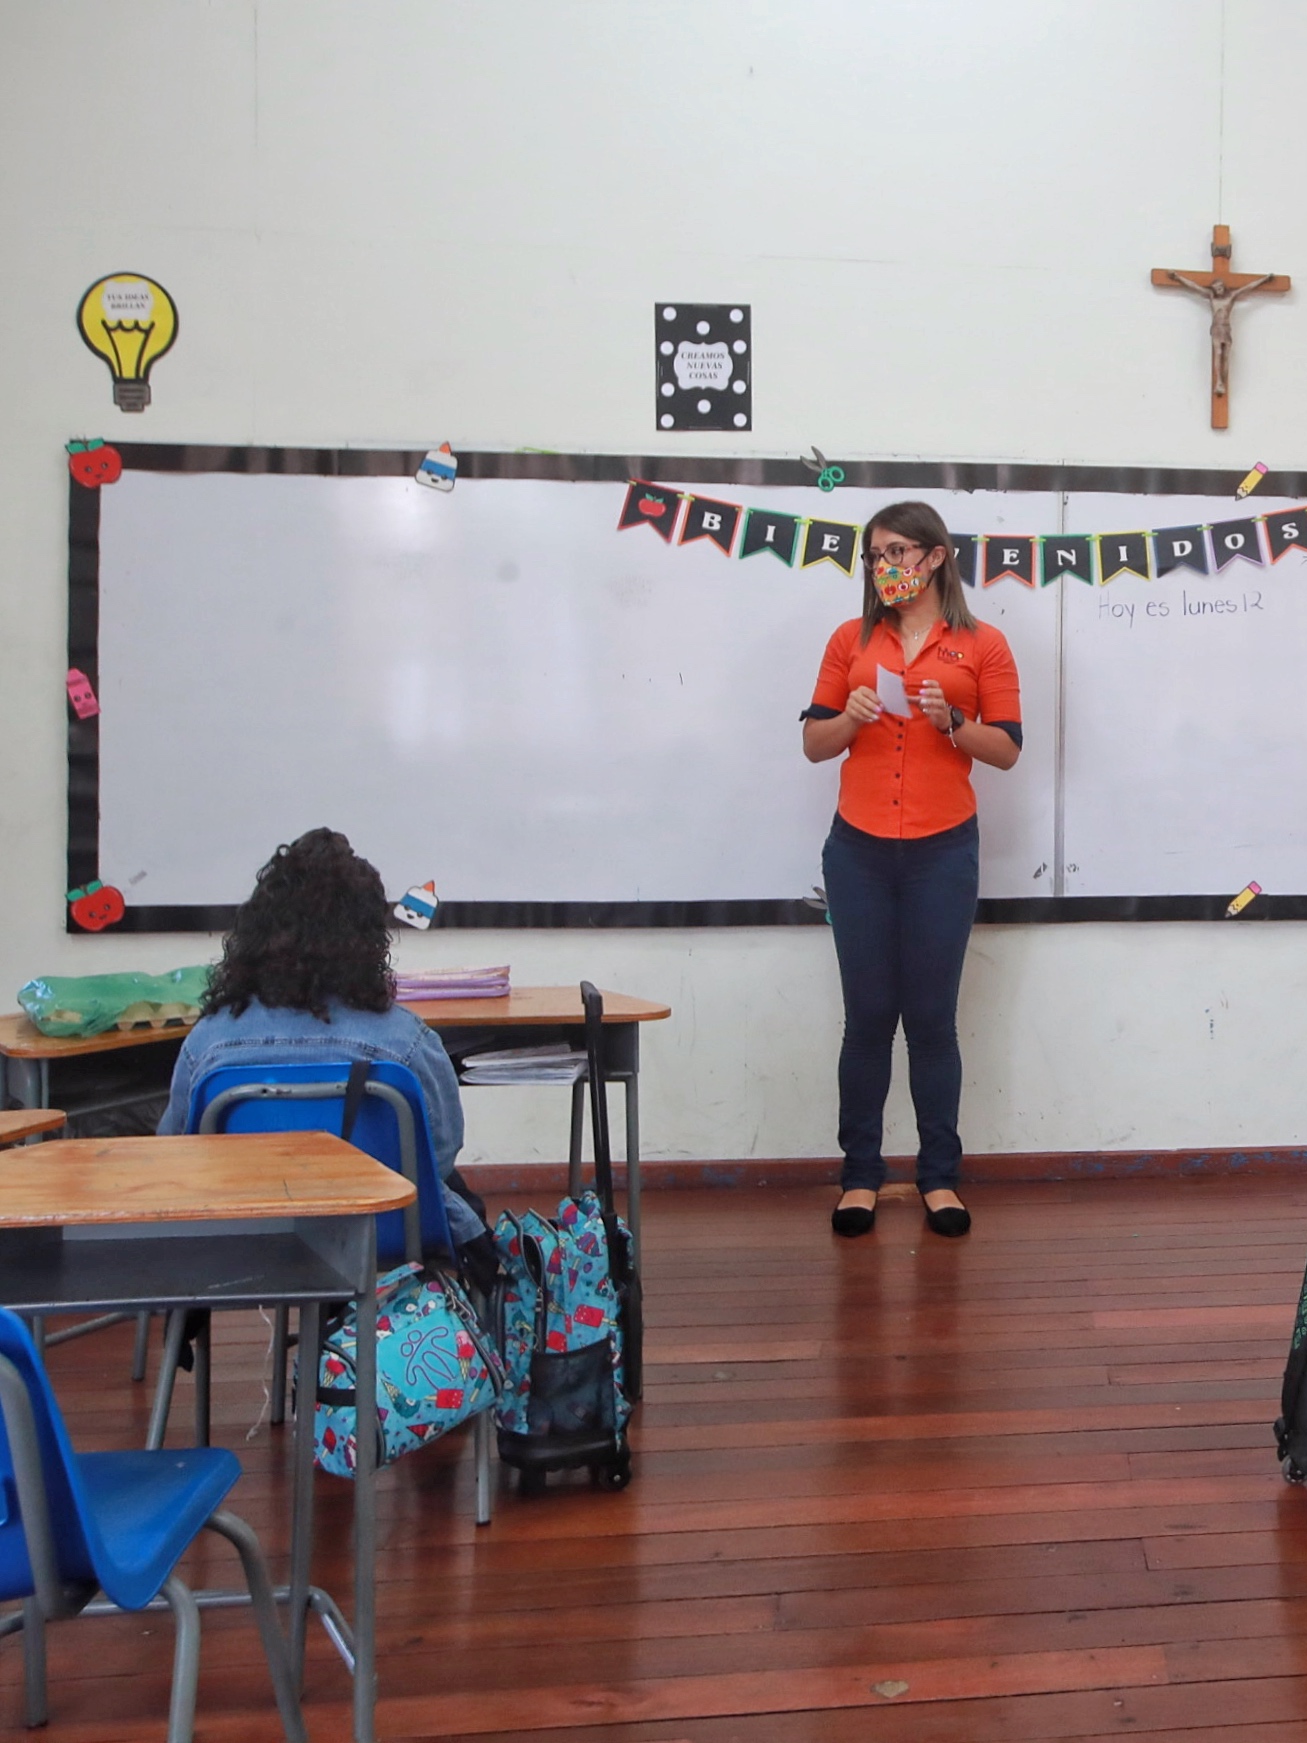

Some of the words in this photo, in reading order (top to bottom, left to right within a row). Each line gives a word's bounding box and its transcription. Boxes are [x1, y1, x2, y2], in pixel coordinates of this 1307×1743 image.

[681, 351, 725, 360] CREAMOS
[687, 361, 723, 370] NUEVAS
[689, 371, 718, 380] COSAS
[702, 511, 1299, 567] BIEENIDOS
[1099, 590, 1135, 628] Hoy
[1146, 601, 1170, 616] es
[1183, 590, 1238, 616] lunes
[1243, 591, 1264, 612] 12
